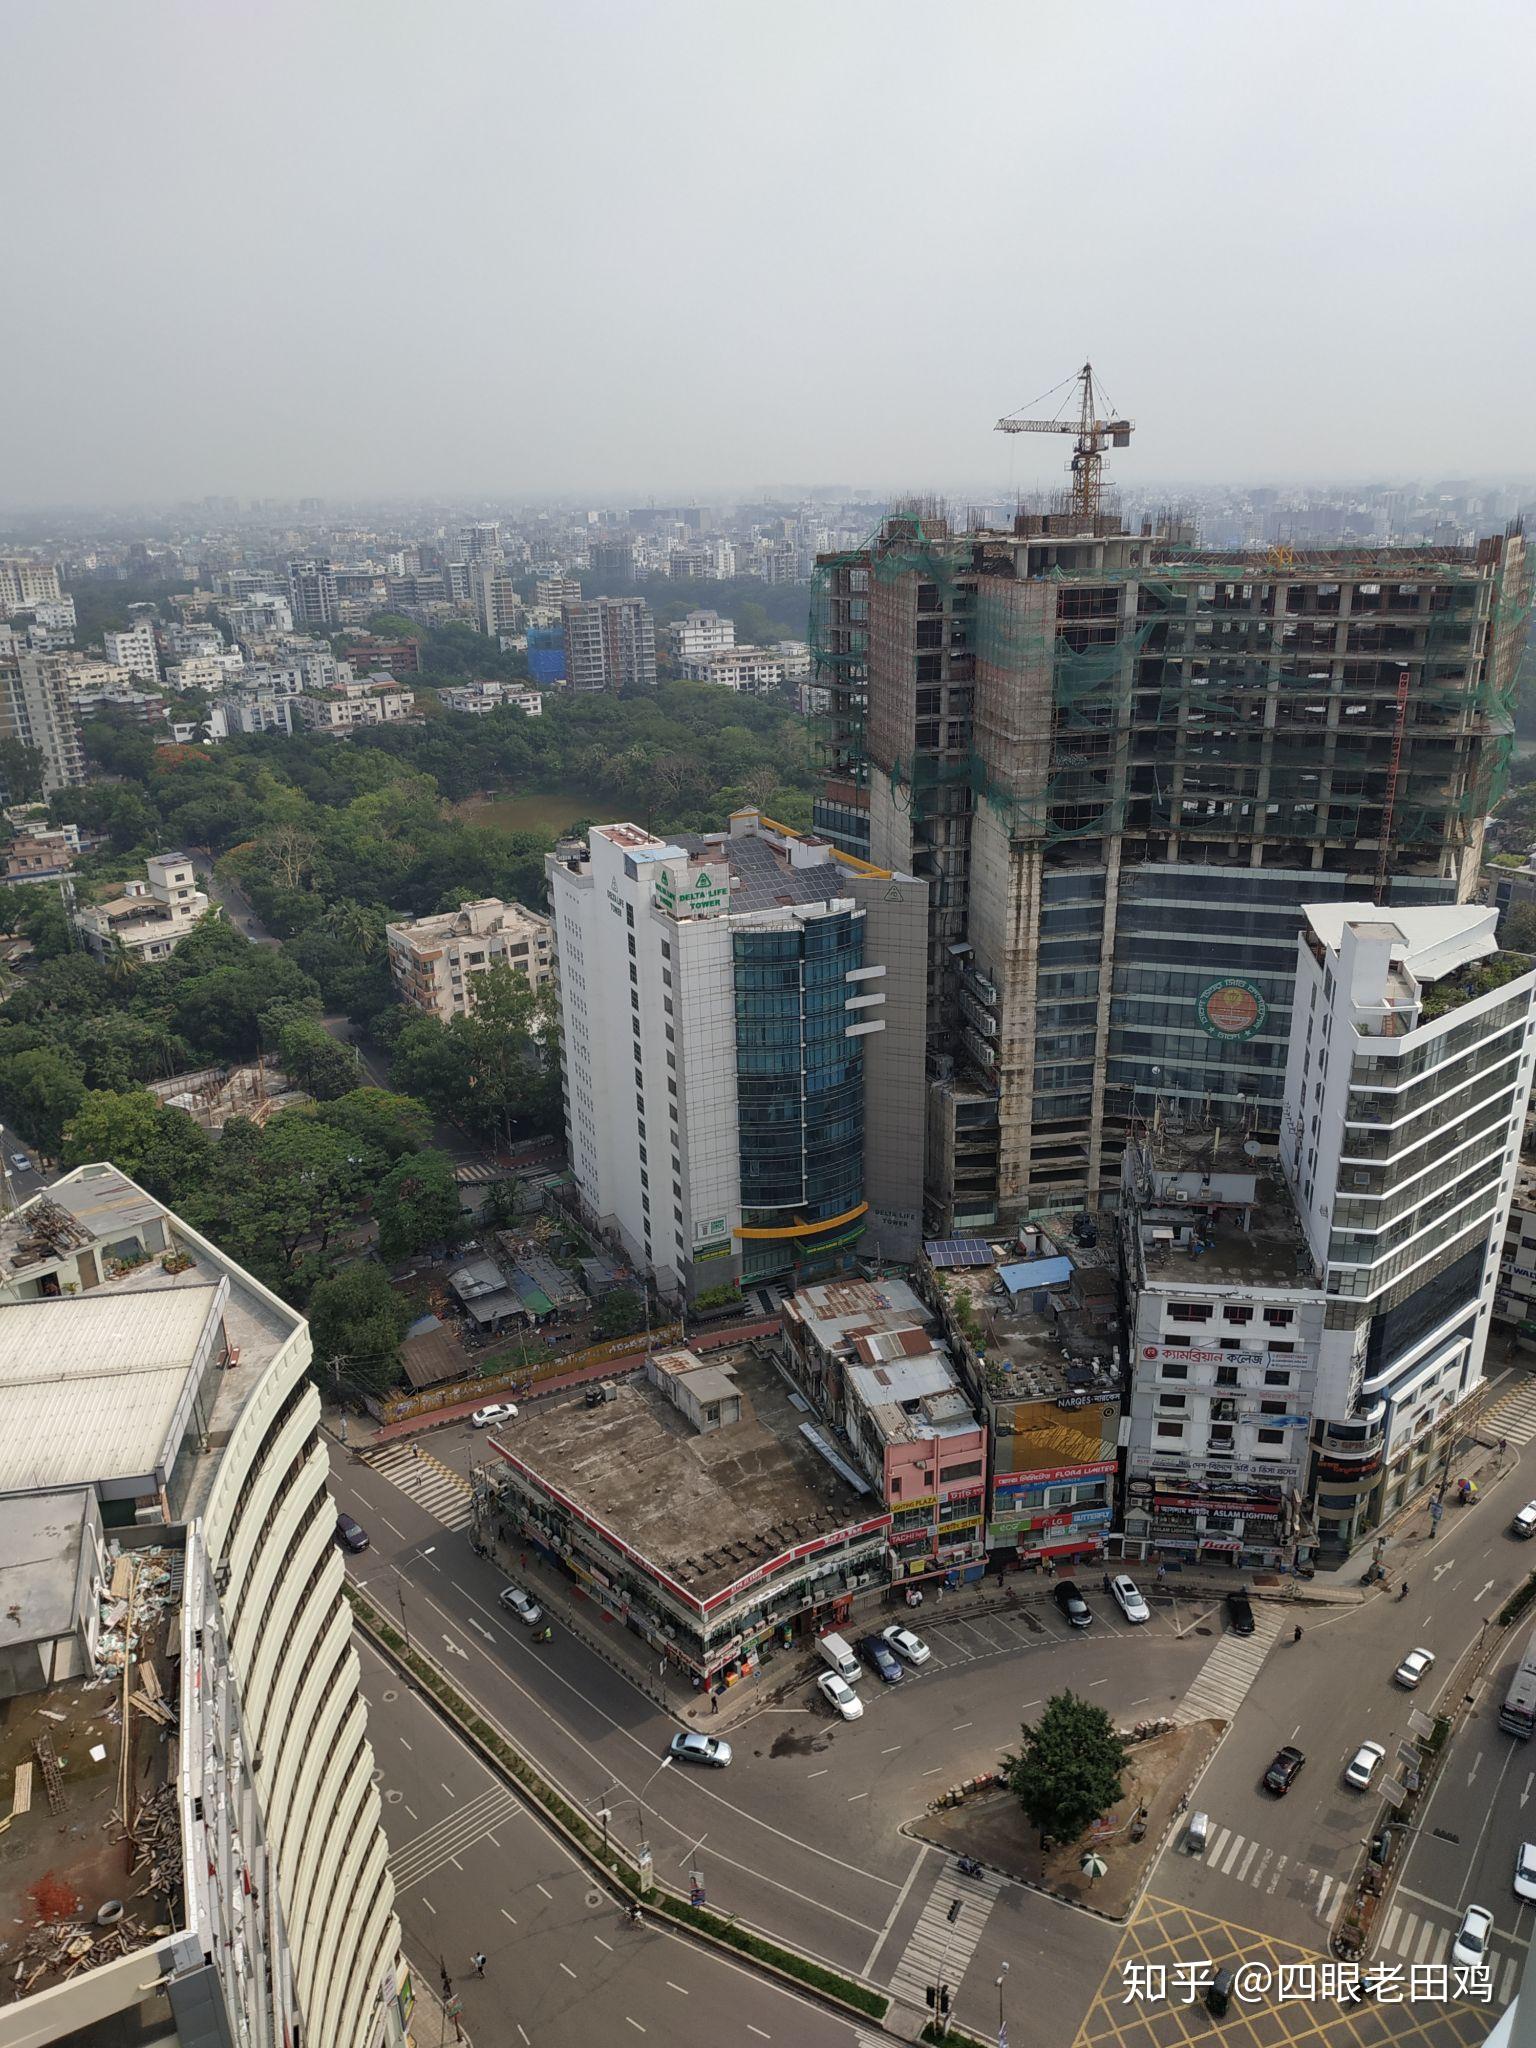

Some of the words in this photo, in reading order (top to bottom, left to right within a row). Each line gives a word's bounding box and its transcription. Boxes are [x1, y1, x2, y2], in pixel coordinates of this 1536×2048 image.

[680, 891, 705, 902] DELTA
[708, 887, 728, 898] LIFE
[690, 899, 721, 910] TOWER
[875, 1209, 898, 1218] DELTA
[900, 1212, 916, 1220] LIFE
[883, 1218, 908, 1228] TOWER
[1162, 1348, 1224, 1363] ক্যামব্রিয়ান
[1226, 1353, 1264, 1365] কলেজ
[1055, 1469, 1081, 1478] FLORA
[1084, 1465, 1114, 1474] LIMITED
[891, 1501, 914, 1512] LIGHTING
[915, 1496, 937, 1506] PLAZA
[1074, 1511, 1110, 1521] BUTTERFLY
[1213, 1510, 1241, 1519] ASLAM
[1242, 1511, 1278, 1521] LIGHTING
[1201, 1541, 1242, 1550] Bata
